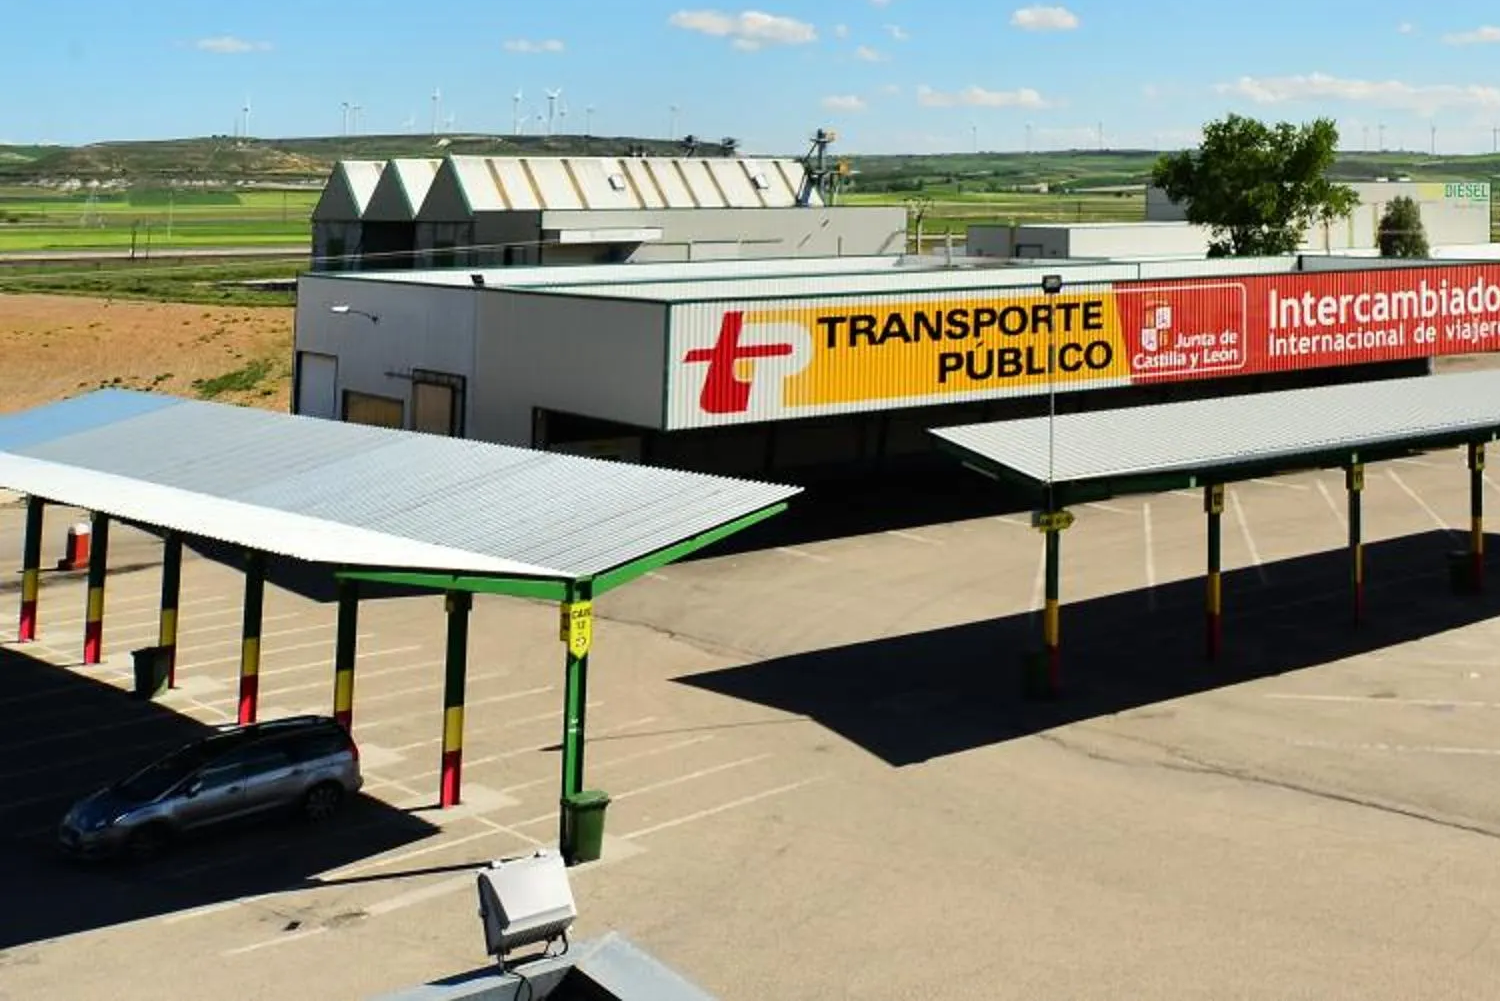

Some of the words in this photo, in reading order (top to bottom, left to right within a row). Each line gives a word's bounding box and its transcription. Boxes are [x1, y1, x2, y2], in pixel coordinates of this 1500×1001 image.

[1444, 184, 1489, 198] DIESEL
[816, 301, 1104, 349] TRANSPORTE
[1173, 331, 1216, 350] Junta
[1219, 328, 1239, 345] de
[1268, 324, 1405, 356] Internacional
[1413, 322, 1437, 344] de
[938, 339, 1114, 384] PÚBLICO
[1132, 350, 1187, 370] Castilla
[1189, 351, 1199, 370] y
